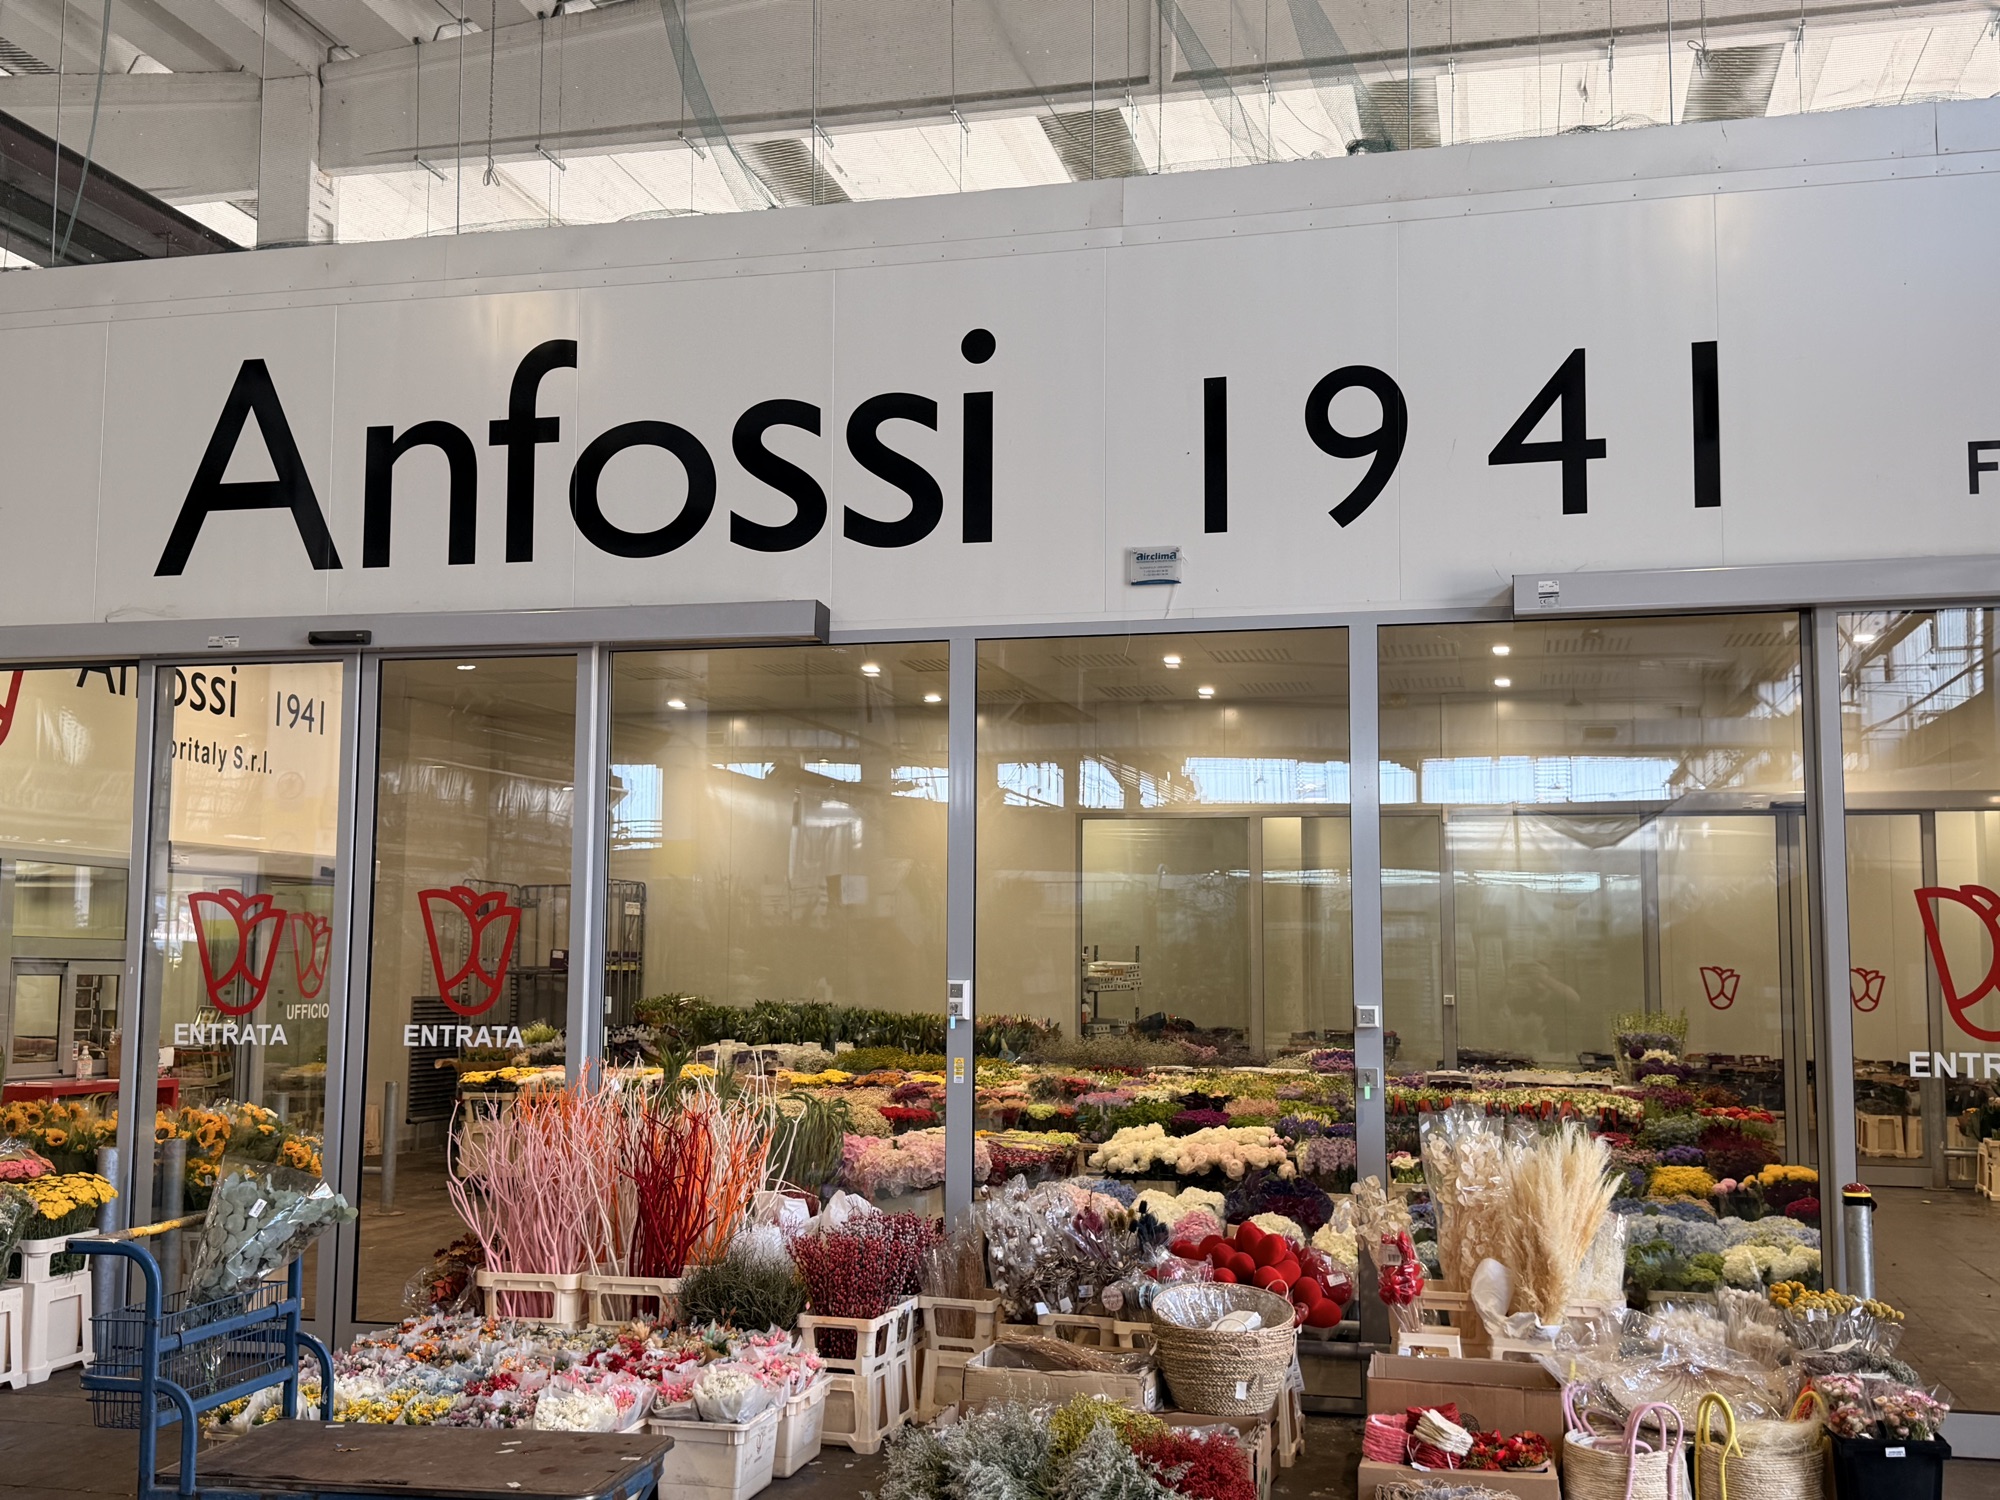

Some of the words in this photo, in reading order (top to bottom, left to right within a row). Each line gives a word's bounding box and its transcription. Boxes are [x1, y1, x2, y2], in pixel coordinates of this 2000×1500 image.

[154, 329, 996, 577] Anfossi
[275, 691, 325, 735] 1941
[233, 745, 273, 774] S.r.l.
[286, 1003, 329, 1020] UFFICIO
[174, 1023, 288, 1046] ENTRATA
[403, 1024, 524, 1048] ENTRATA
[1909, 1051, 2000, 1079] ENTR
